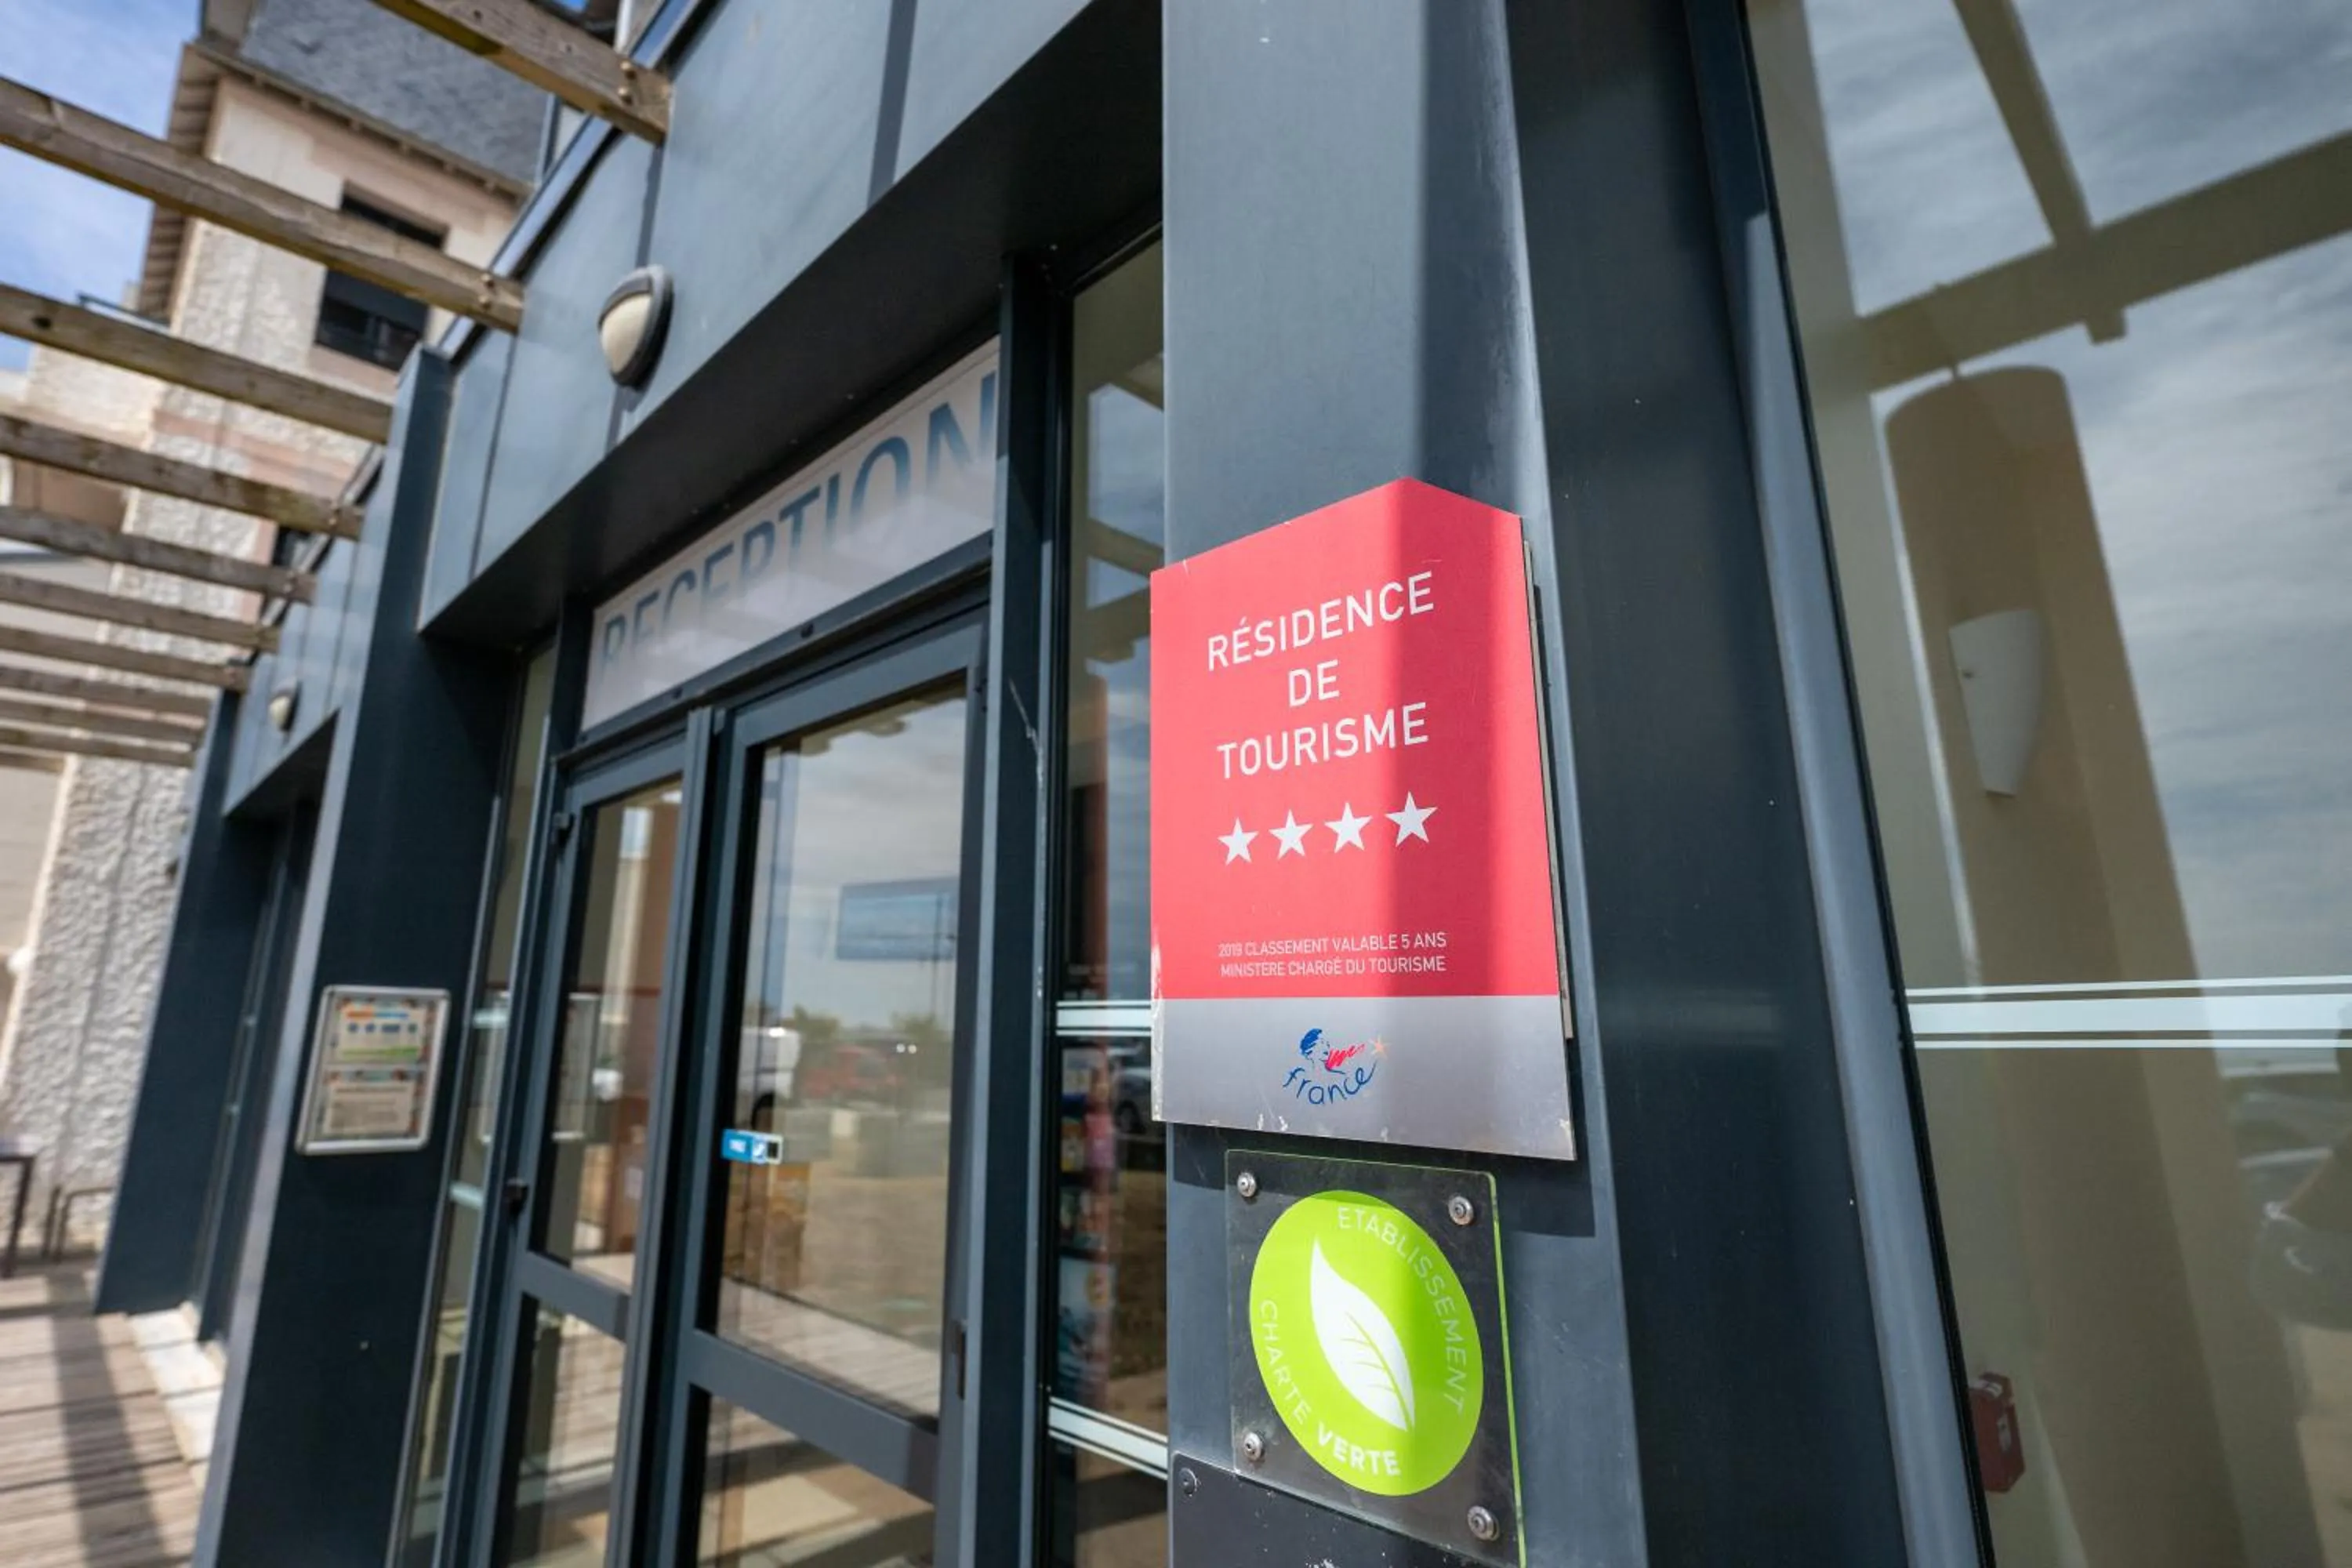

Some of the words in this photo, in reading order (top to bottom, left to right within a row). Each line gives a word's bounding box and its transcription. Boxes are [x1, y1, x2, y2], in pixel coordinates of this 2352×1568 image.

[1207, 571, 1434, 671] RÉSIDENCE
[1288, 659, 1340, 707] DE
[1217, 702, 1429, 779] TOURISME
[1218, 942, 1243, 957] 2019
[1245, 938, 1328, 956] CLASSEMENT
[1332, 934, 1399, 952] VALABLE
[1401, 934, 1410, 949] 5
[1414, 932, 1446, 949] ANS
[1345, 959, 1365, 975] DU
[1368, 956, 1446, 973] TOURISME
[1282, 1062, 1377, 1105] france
[1337, 1207, 1467, 1415] ETABLISSEMENT
[1259, 1299, 1312, 1425] CHARTE
[1317, 1425, 1402, 1475] VERTE
